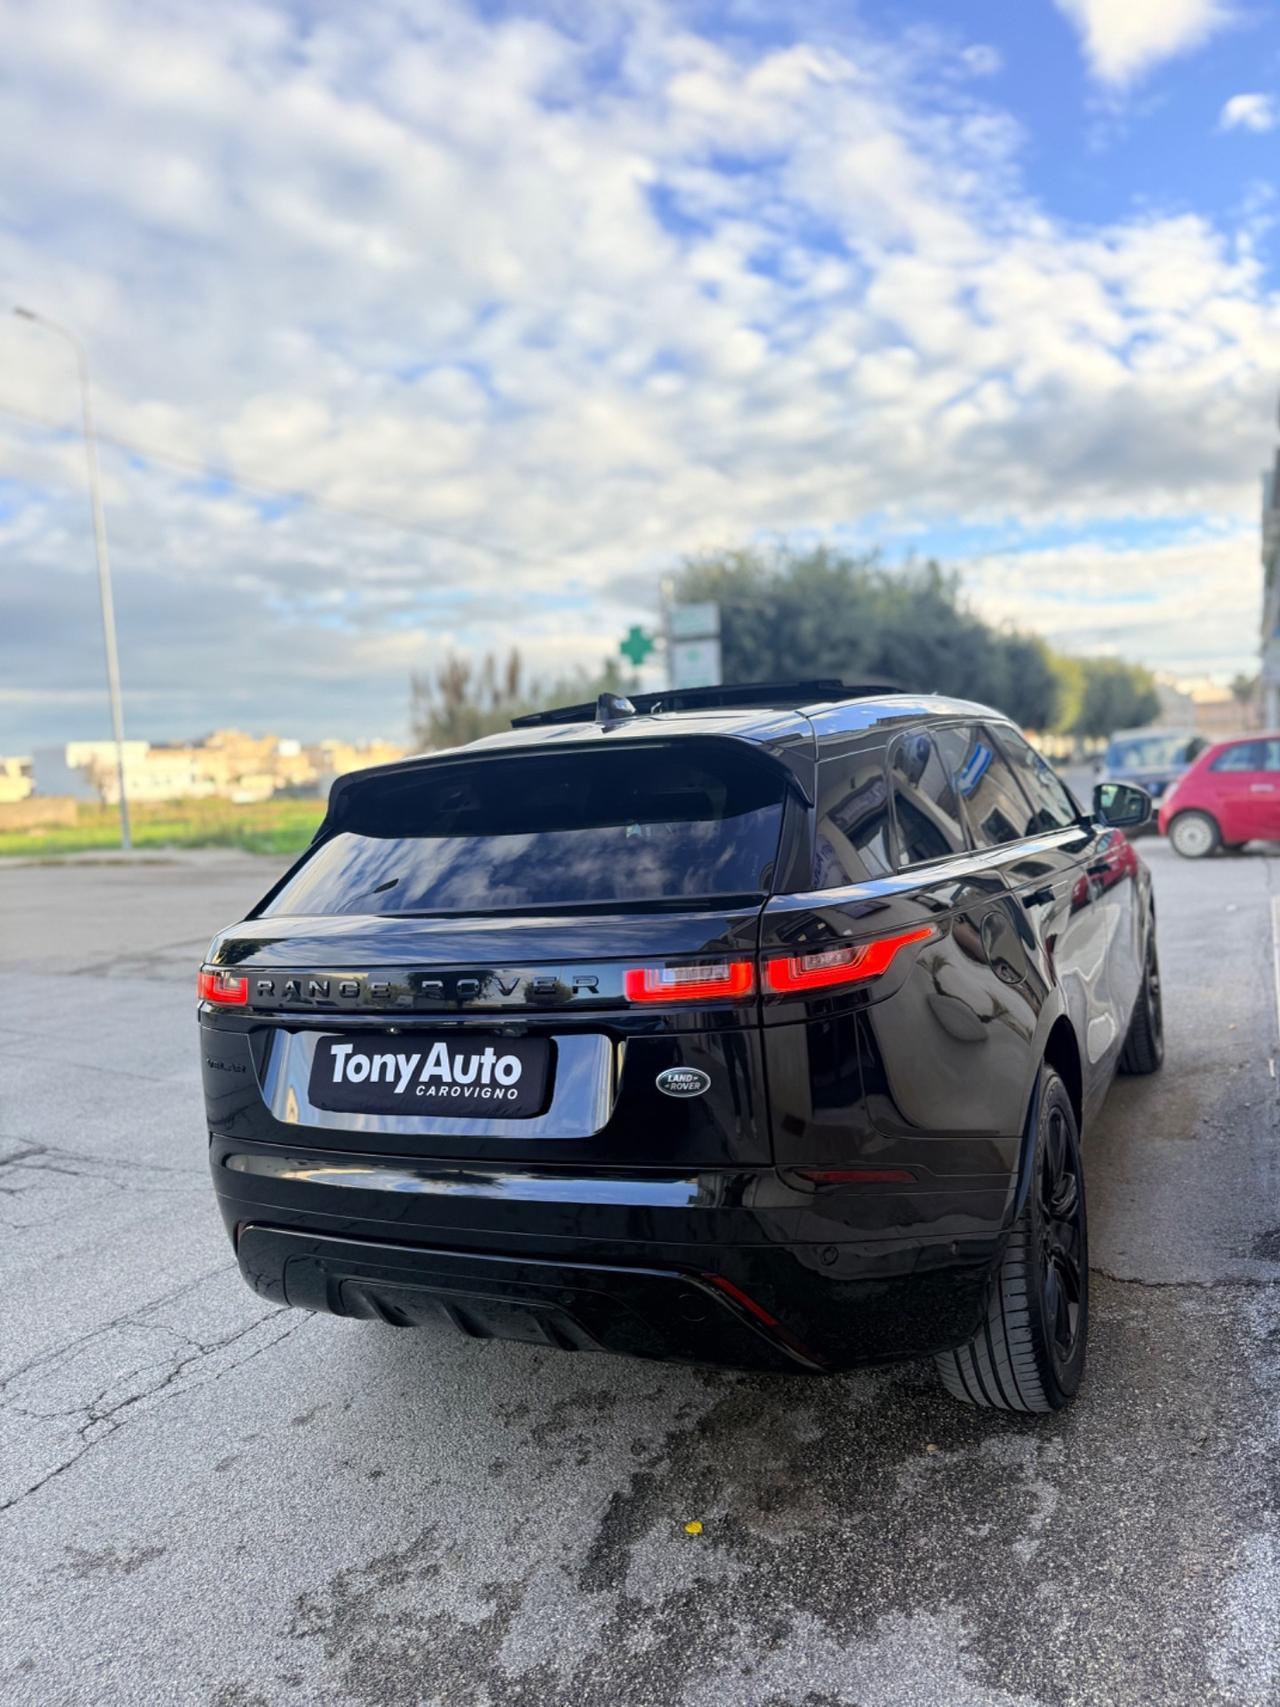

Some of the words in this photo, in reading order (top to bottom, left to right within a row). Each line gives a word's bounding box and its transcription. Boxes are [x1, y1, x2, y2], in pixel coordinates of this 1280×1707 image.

[257, 979, 393, 1000] RANGE
[421, 975, 600, 1000] ROVER
[415, 1085, 519, 1100] CAROVIGNO
